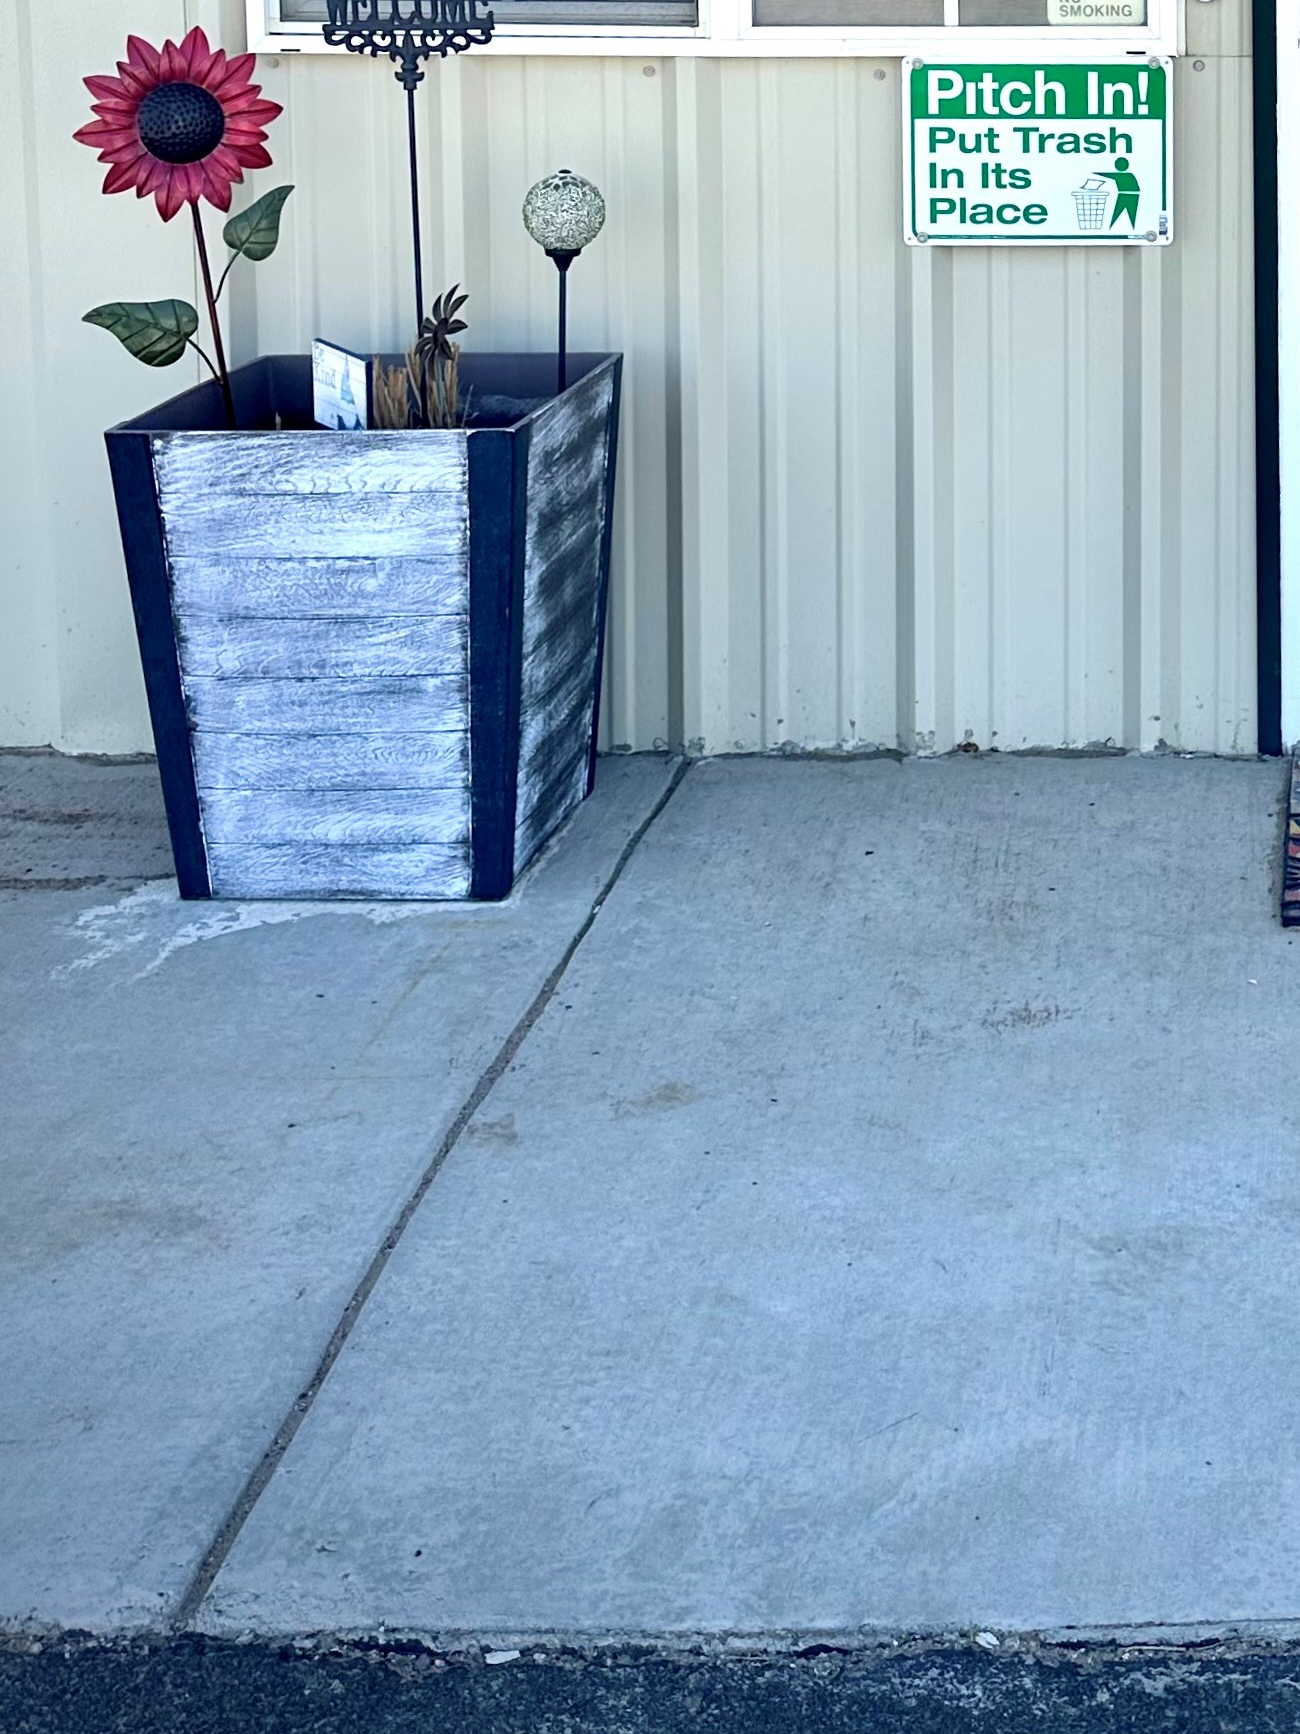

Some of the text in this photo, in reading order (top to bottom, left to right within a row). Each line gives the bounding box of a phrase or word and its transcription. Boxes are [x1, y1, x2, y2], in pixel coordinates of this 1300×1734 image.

[1059, 4, 1133, 18] SMOKING
[927, 69, 1150, 116] Pitch In!
[928, 126, 1133, 154] Put Trash
[929, 162, 1033, 190] In Its
[929, 197, 1049, 224] Place
[313, 360, 337, 389] Kind
